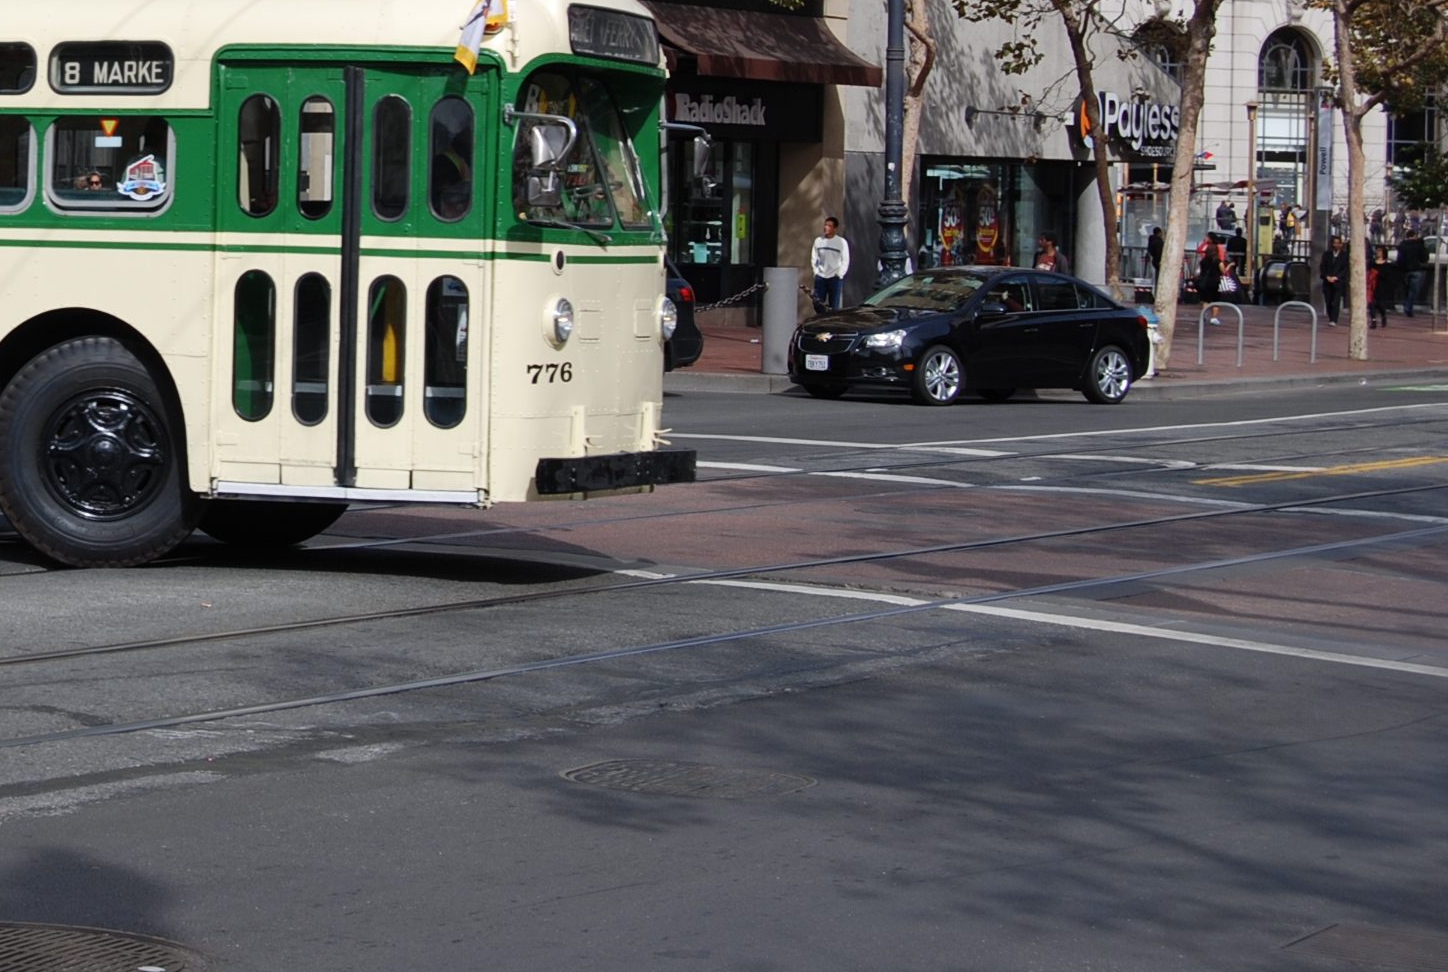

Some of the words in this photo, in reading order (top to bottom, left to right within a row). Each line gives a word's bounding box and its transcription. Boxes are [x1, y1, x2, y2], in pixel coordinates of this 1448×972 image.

[64, 62, 81, 84] 8
[93, 61, 170, 84] MARKE
[674, 92, 766, 126] RadioShack
[1104, 92, 1180, 150] Payless
[1318, 146, 1327, 176] Powell
[526, 361, 573, 384] 776
